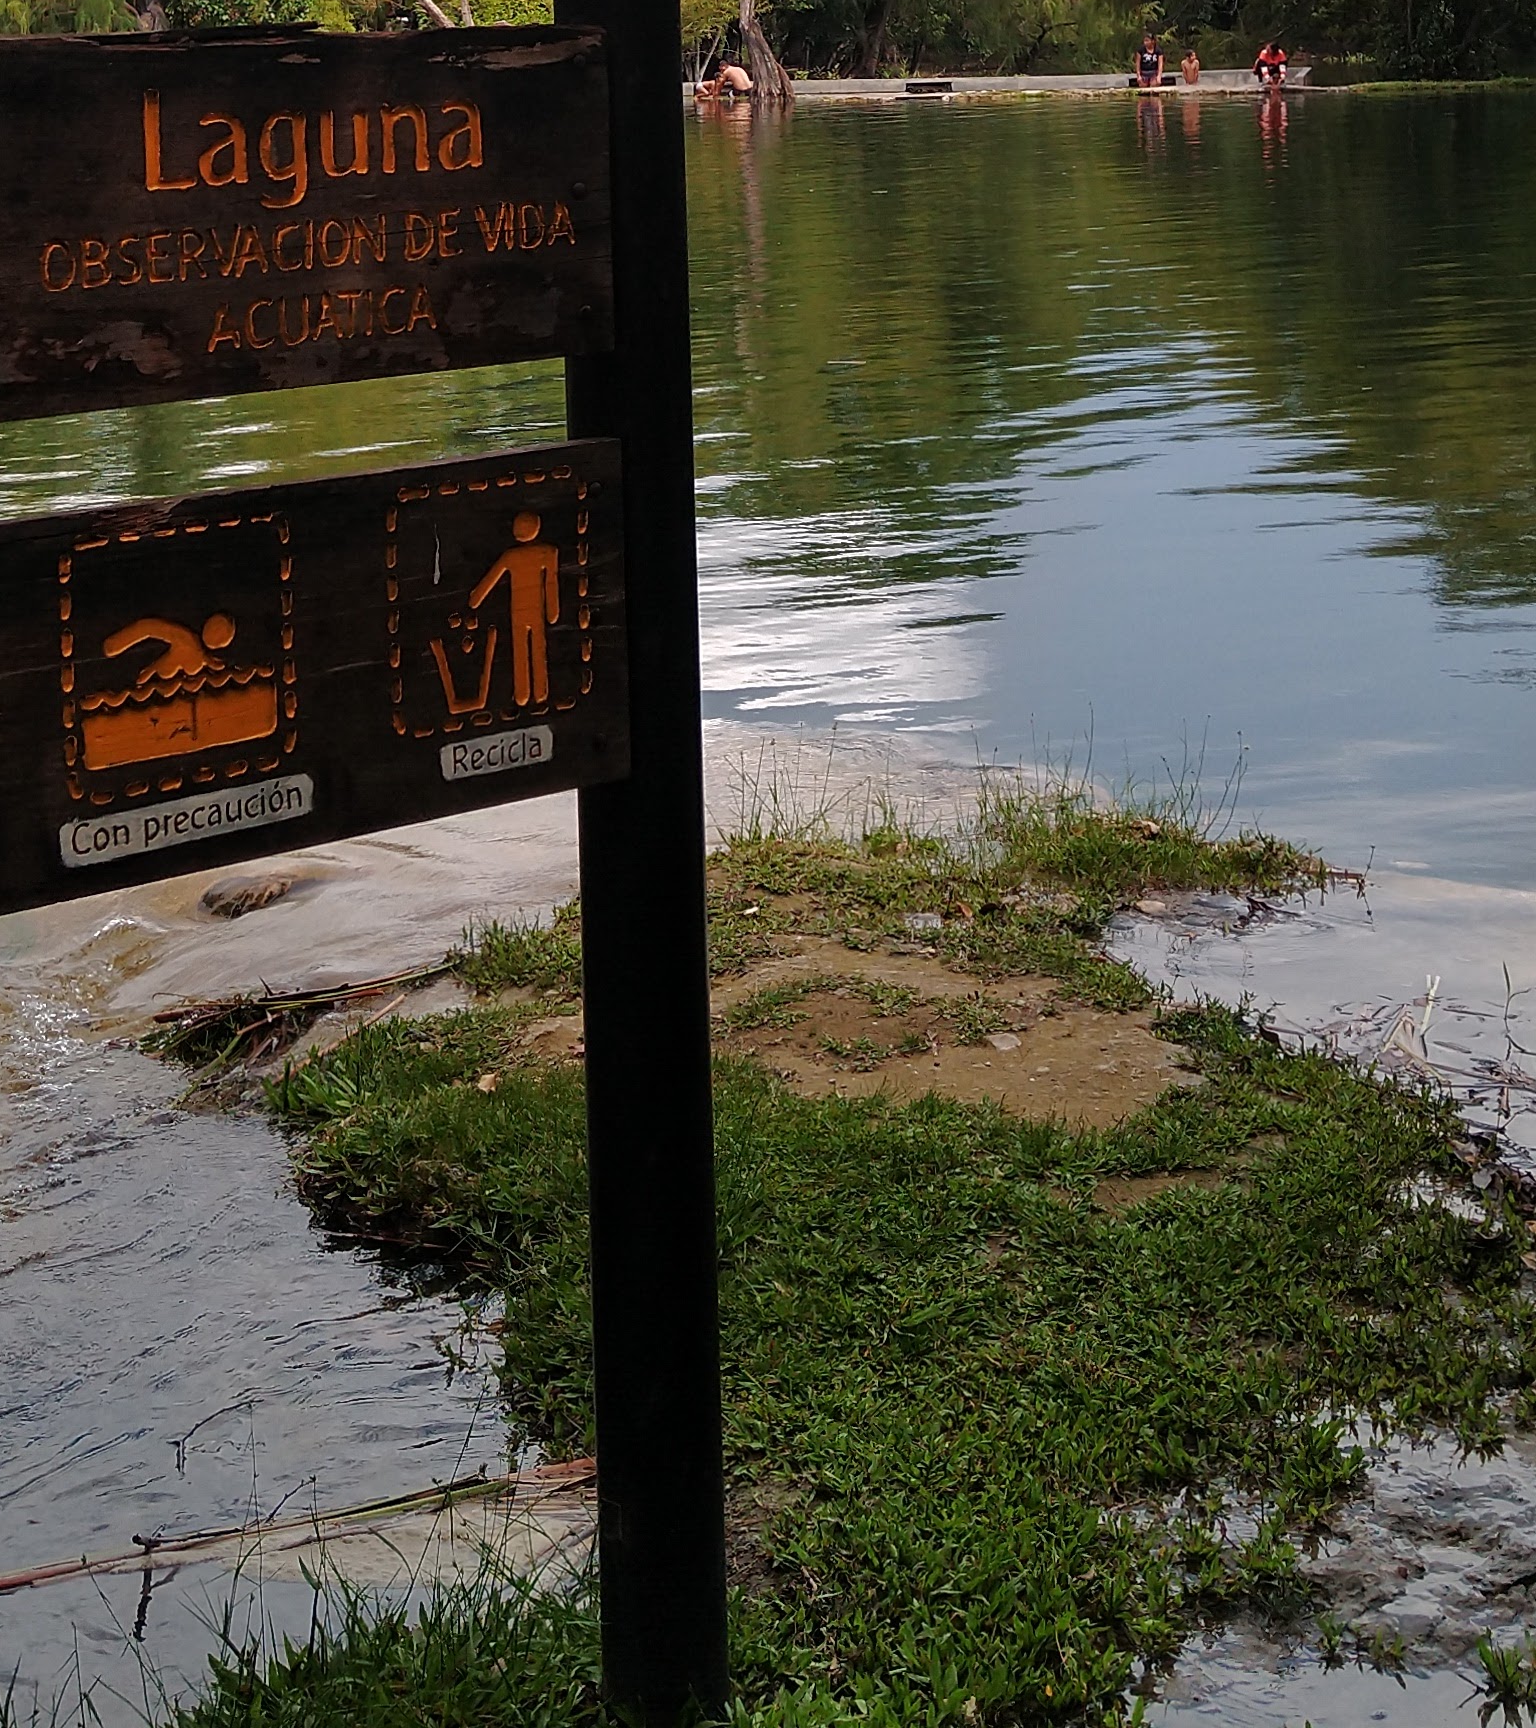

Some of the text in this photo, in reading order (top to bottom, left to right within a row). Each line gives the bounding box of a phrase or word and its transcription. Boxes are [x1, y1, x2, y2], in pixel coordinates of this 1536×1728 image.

[142, 88, 485, 208] Laguna
[39, 198, 577, 292] OBSERVACION DE VIDA
[207, 283, 438, 353] ACUATICA
[452, 733, 542, 775] Recicla
[71, 781, 303, 855] Con precaución
